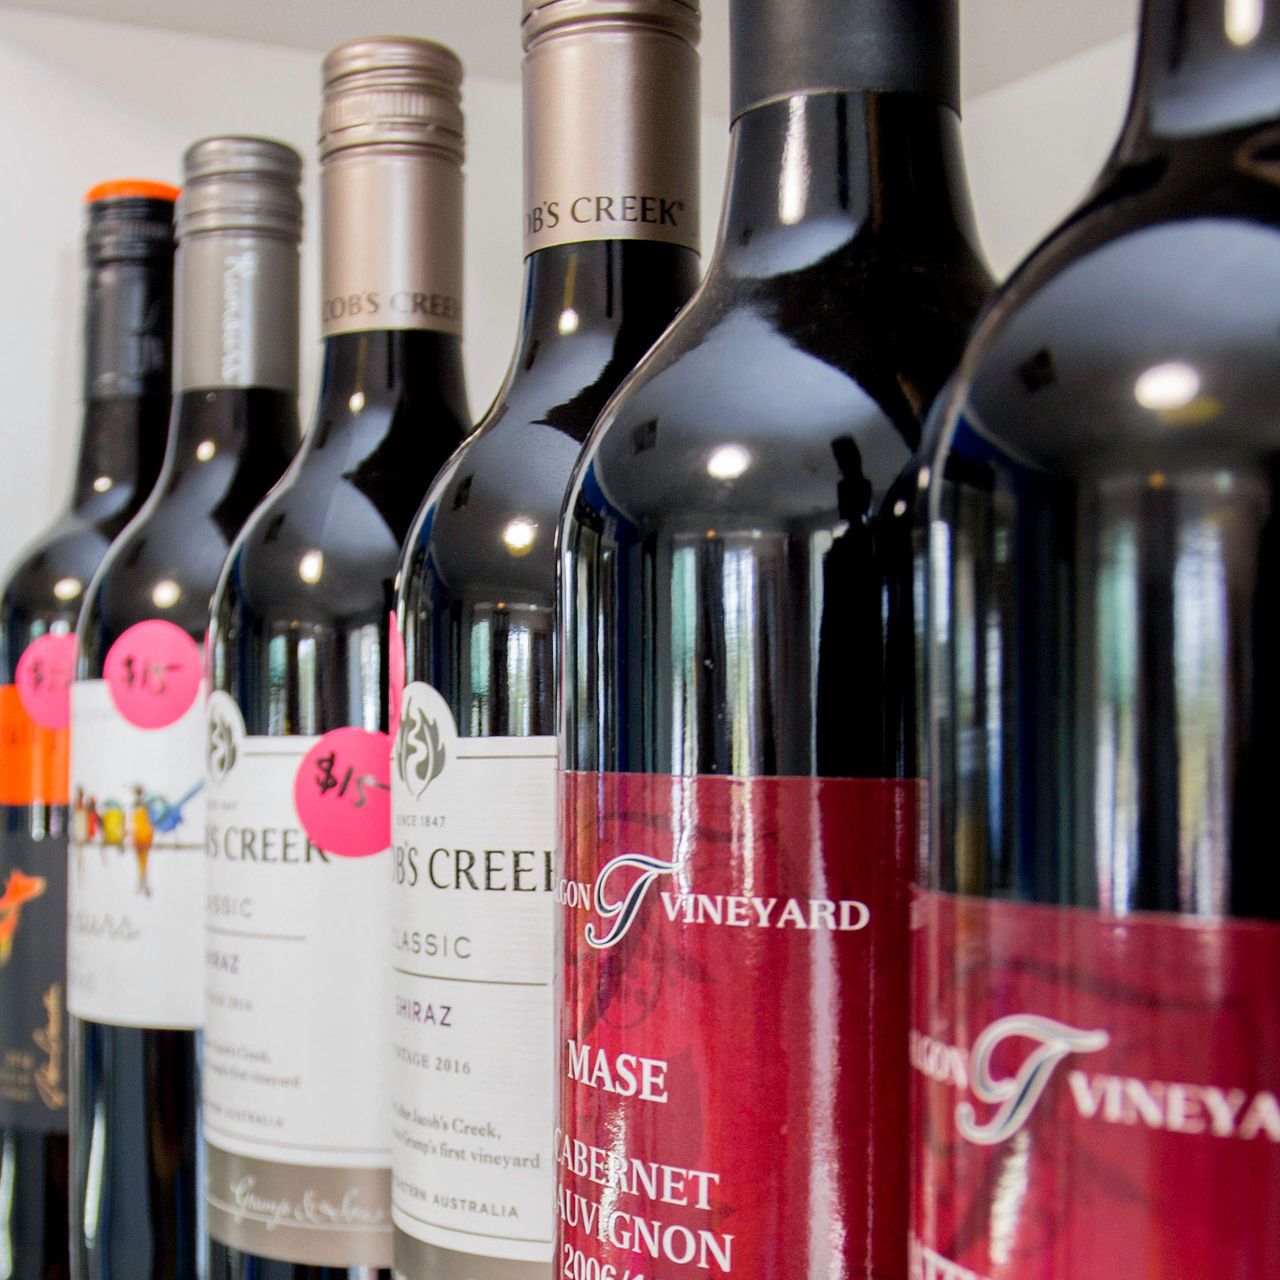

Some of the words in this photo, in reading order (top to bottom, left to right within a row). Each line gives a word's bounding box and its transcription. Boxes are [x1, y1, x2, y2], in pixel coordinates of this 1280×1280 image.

[659, 889, 871, 932] VINEYARD
[435, 1056, 472, 1075] 2016
[566, 1038, 669, 1104] MASE
[451, 1118, 502, 1142] Creek,
[470, 1149, 542, 1170] vineyard
[431, 1193, 520, 1219] AUSTRALIA
[555, 1183, 736, 1274] AUVIGNON
